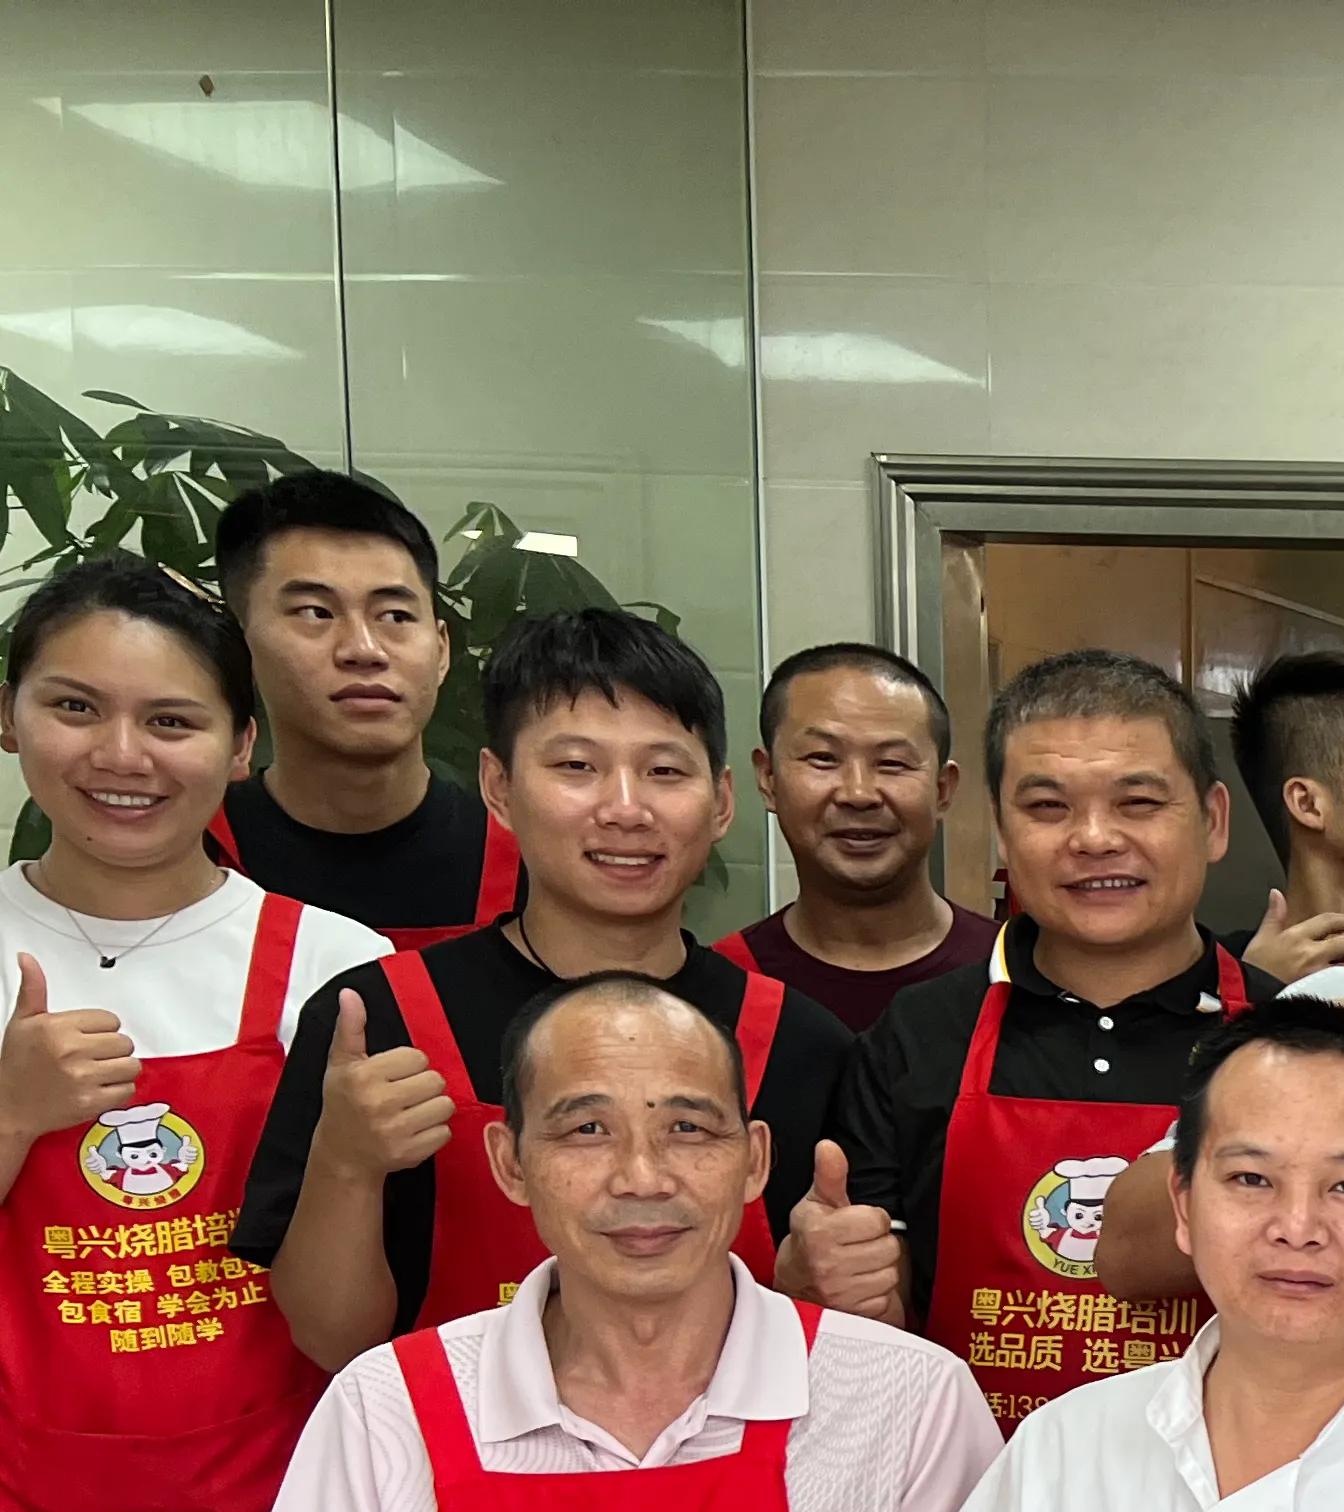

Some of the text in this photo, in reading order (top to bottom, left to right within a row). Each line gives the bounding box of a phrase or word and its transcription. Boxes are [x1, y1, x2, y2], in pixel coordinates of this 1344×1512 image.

[42, 1269, 155, 1295] 全程实操
[57, 1281, 268, 1324] 包食宿 学会为止
[969, 1287, 1198, 1337] 粤兴烧腊培训
[109, 1316, 224, 1353] 随到随学
[968, 1331, 1063, 1371] 选品质
